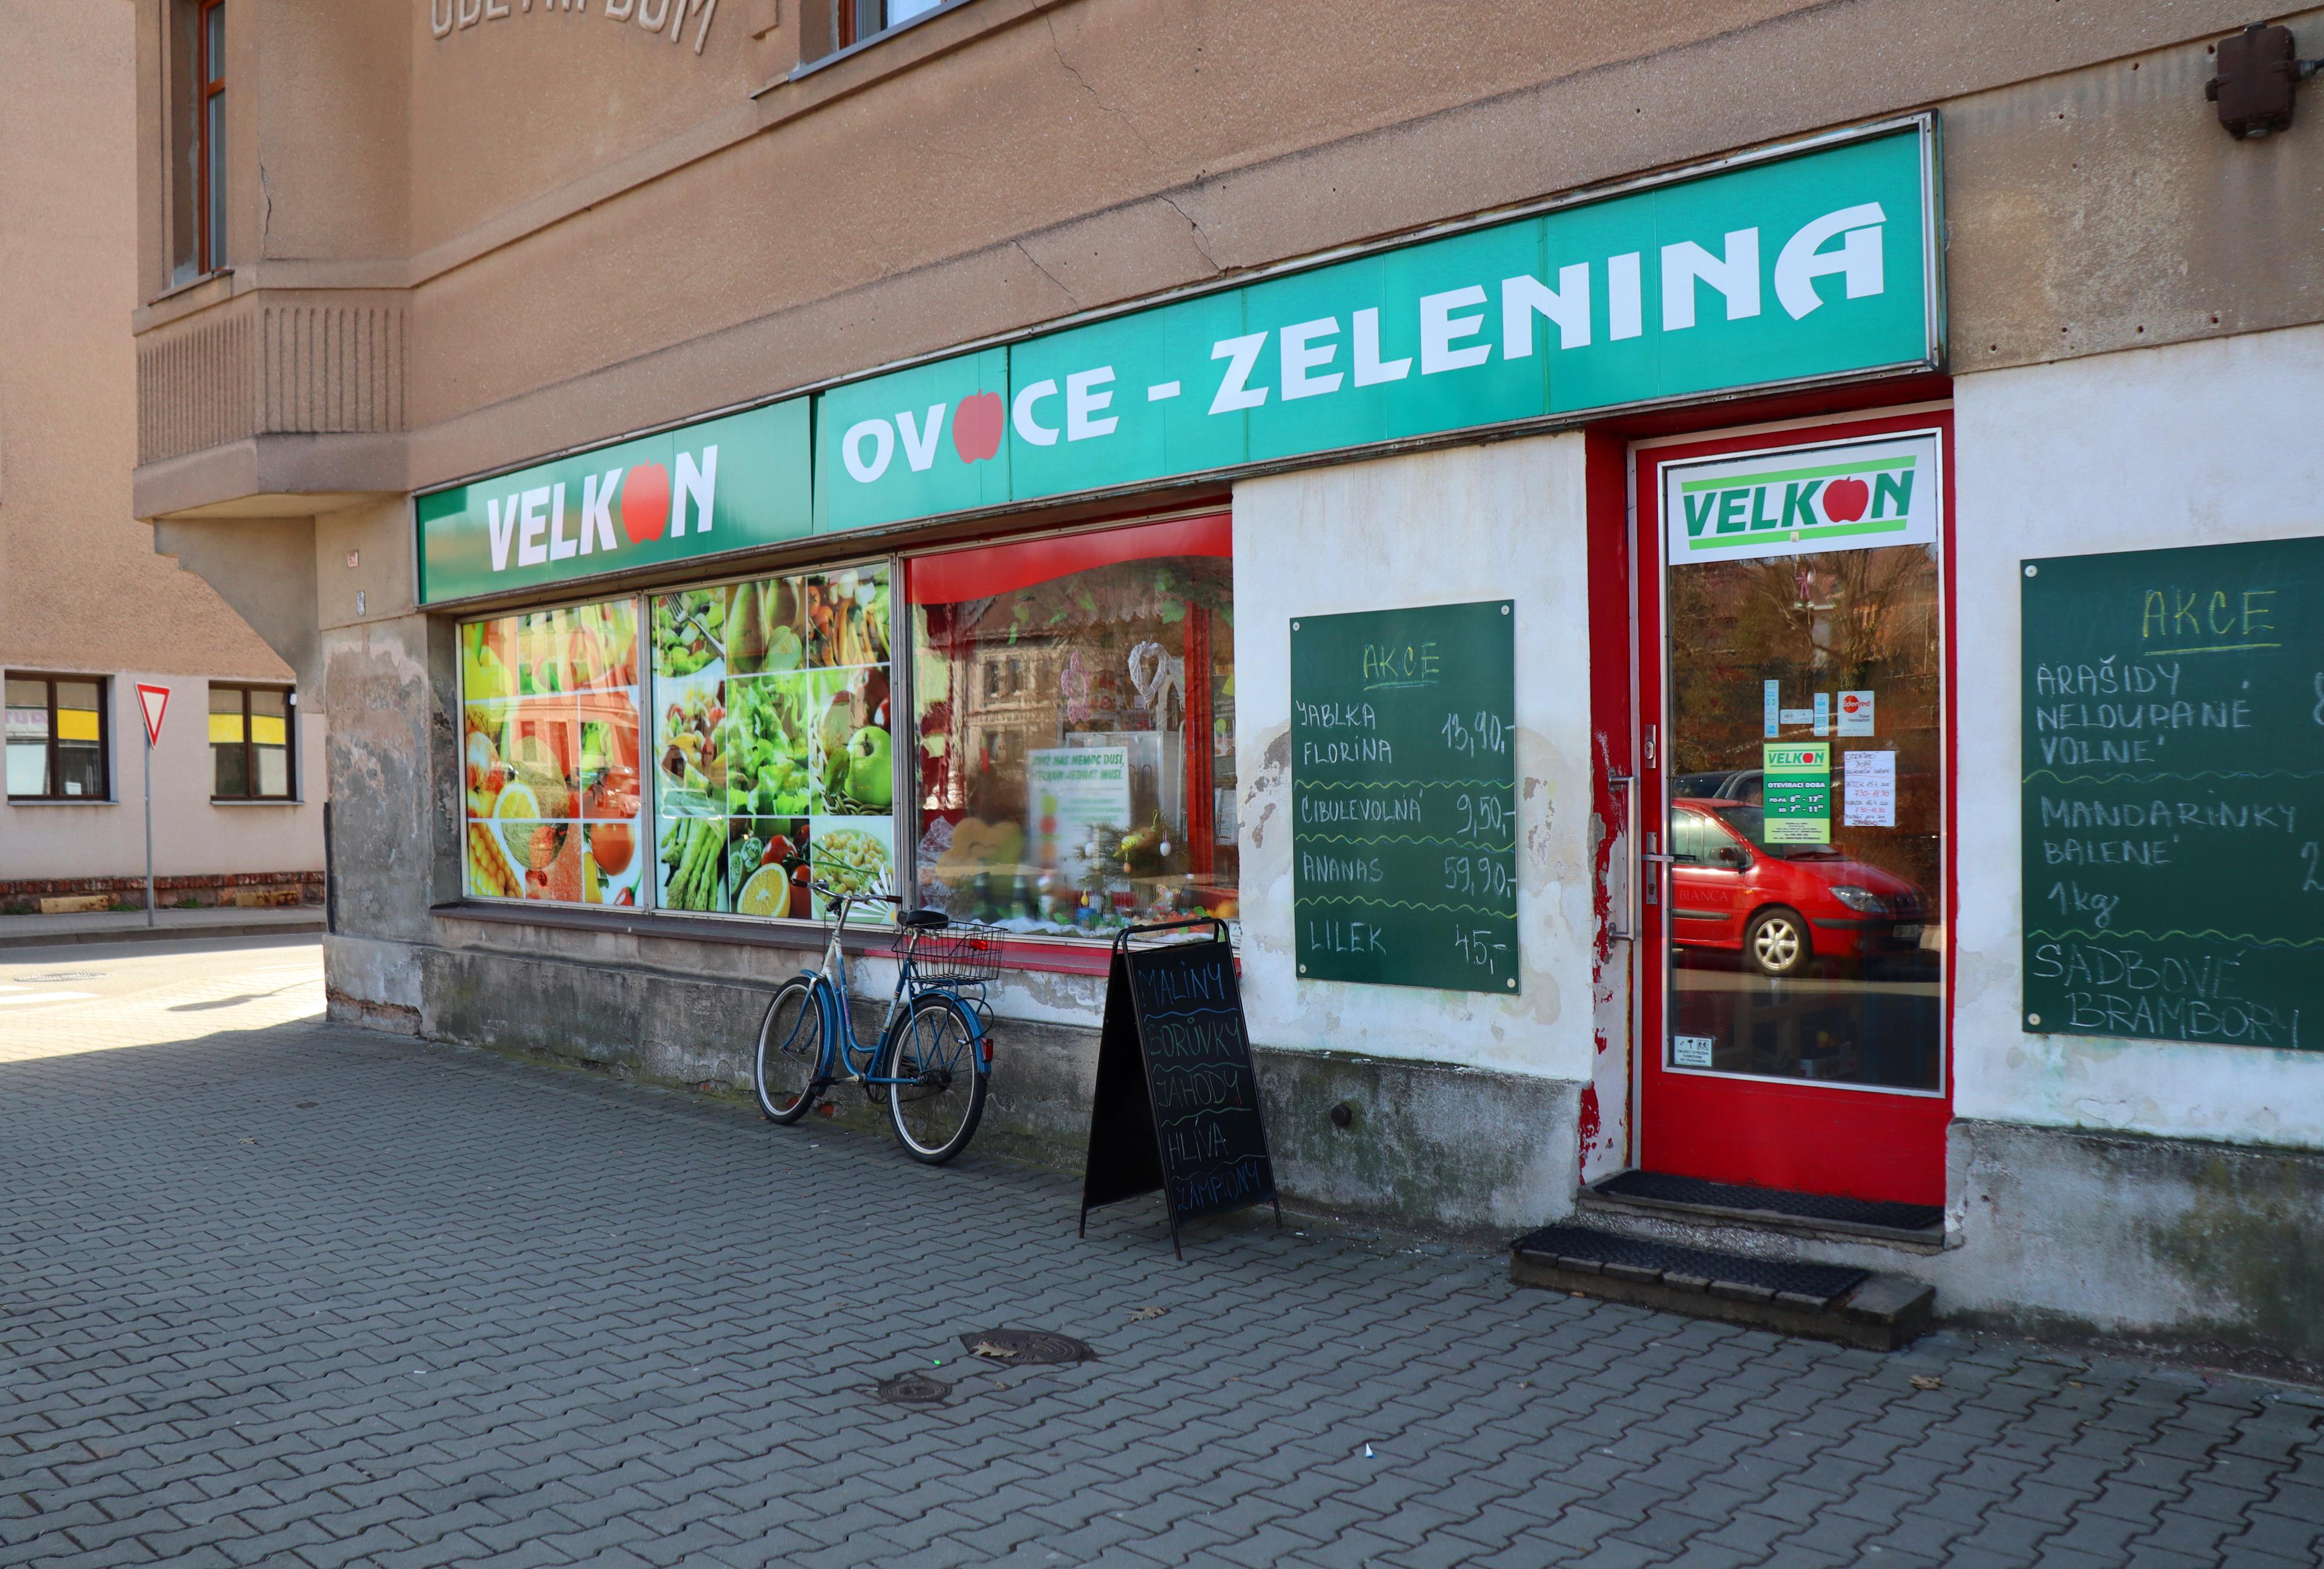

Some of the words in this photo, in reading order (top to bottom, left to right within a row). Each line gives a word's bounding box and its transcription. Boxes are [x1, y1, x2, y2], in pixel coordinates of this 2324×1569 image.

[842, 365, 1119, 483] OVOCE
[1208, 202, 1887, 415] ZELENINA
[487, 444, 718, 572] VELKON
[1683, 470, 1914, 536] VELKON
[2143, 589, 2276, 637] AKCE
[1364, 642, 1439, 678] AKCE
[1071, 755, 1101, 765] NEMOC
[1769, 752, 1824, 763] VELKON
[1303, 851, 1383, 882] ANANAS
[1310, 920, 1386, 955] LILEK
[2064, 992, 2299, 1047] BRAMBORY
[1156, 1070, 1242, 1107] JAHODY
